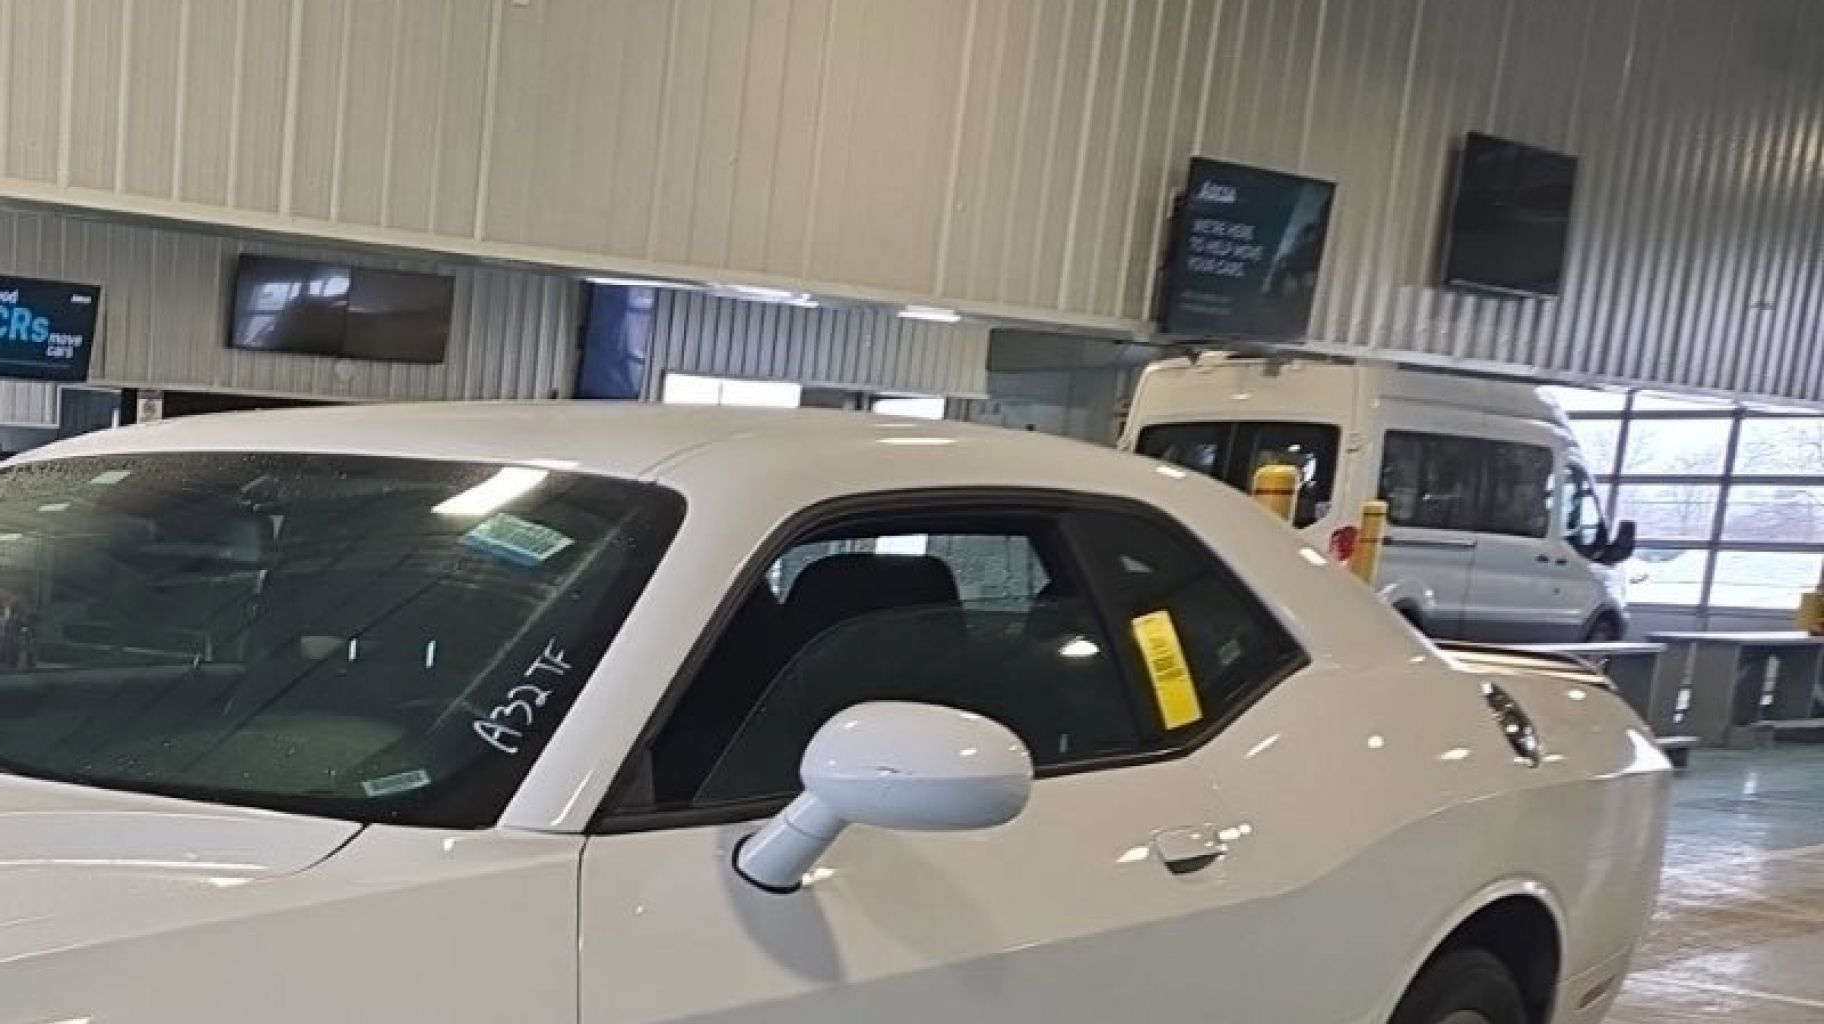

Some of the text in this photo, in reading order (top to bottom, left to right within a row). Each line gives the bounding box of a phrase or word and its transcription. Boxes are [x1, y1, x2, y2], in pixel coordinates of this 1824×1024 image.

[48, 333, 82, 347] move
[46, 346, 74, 359] cars
[473, 685, 552, 753] A32
